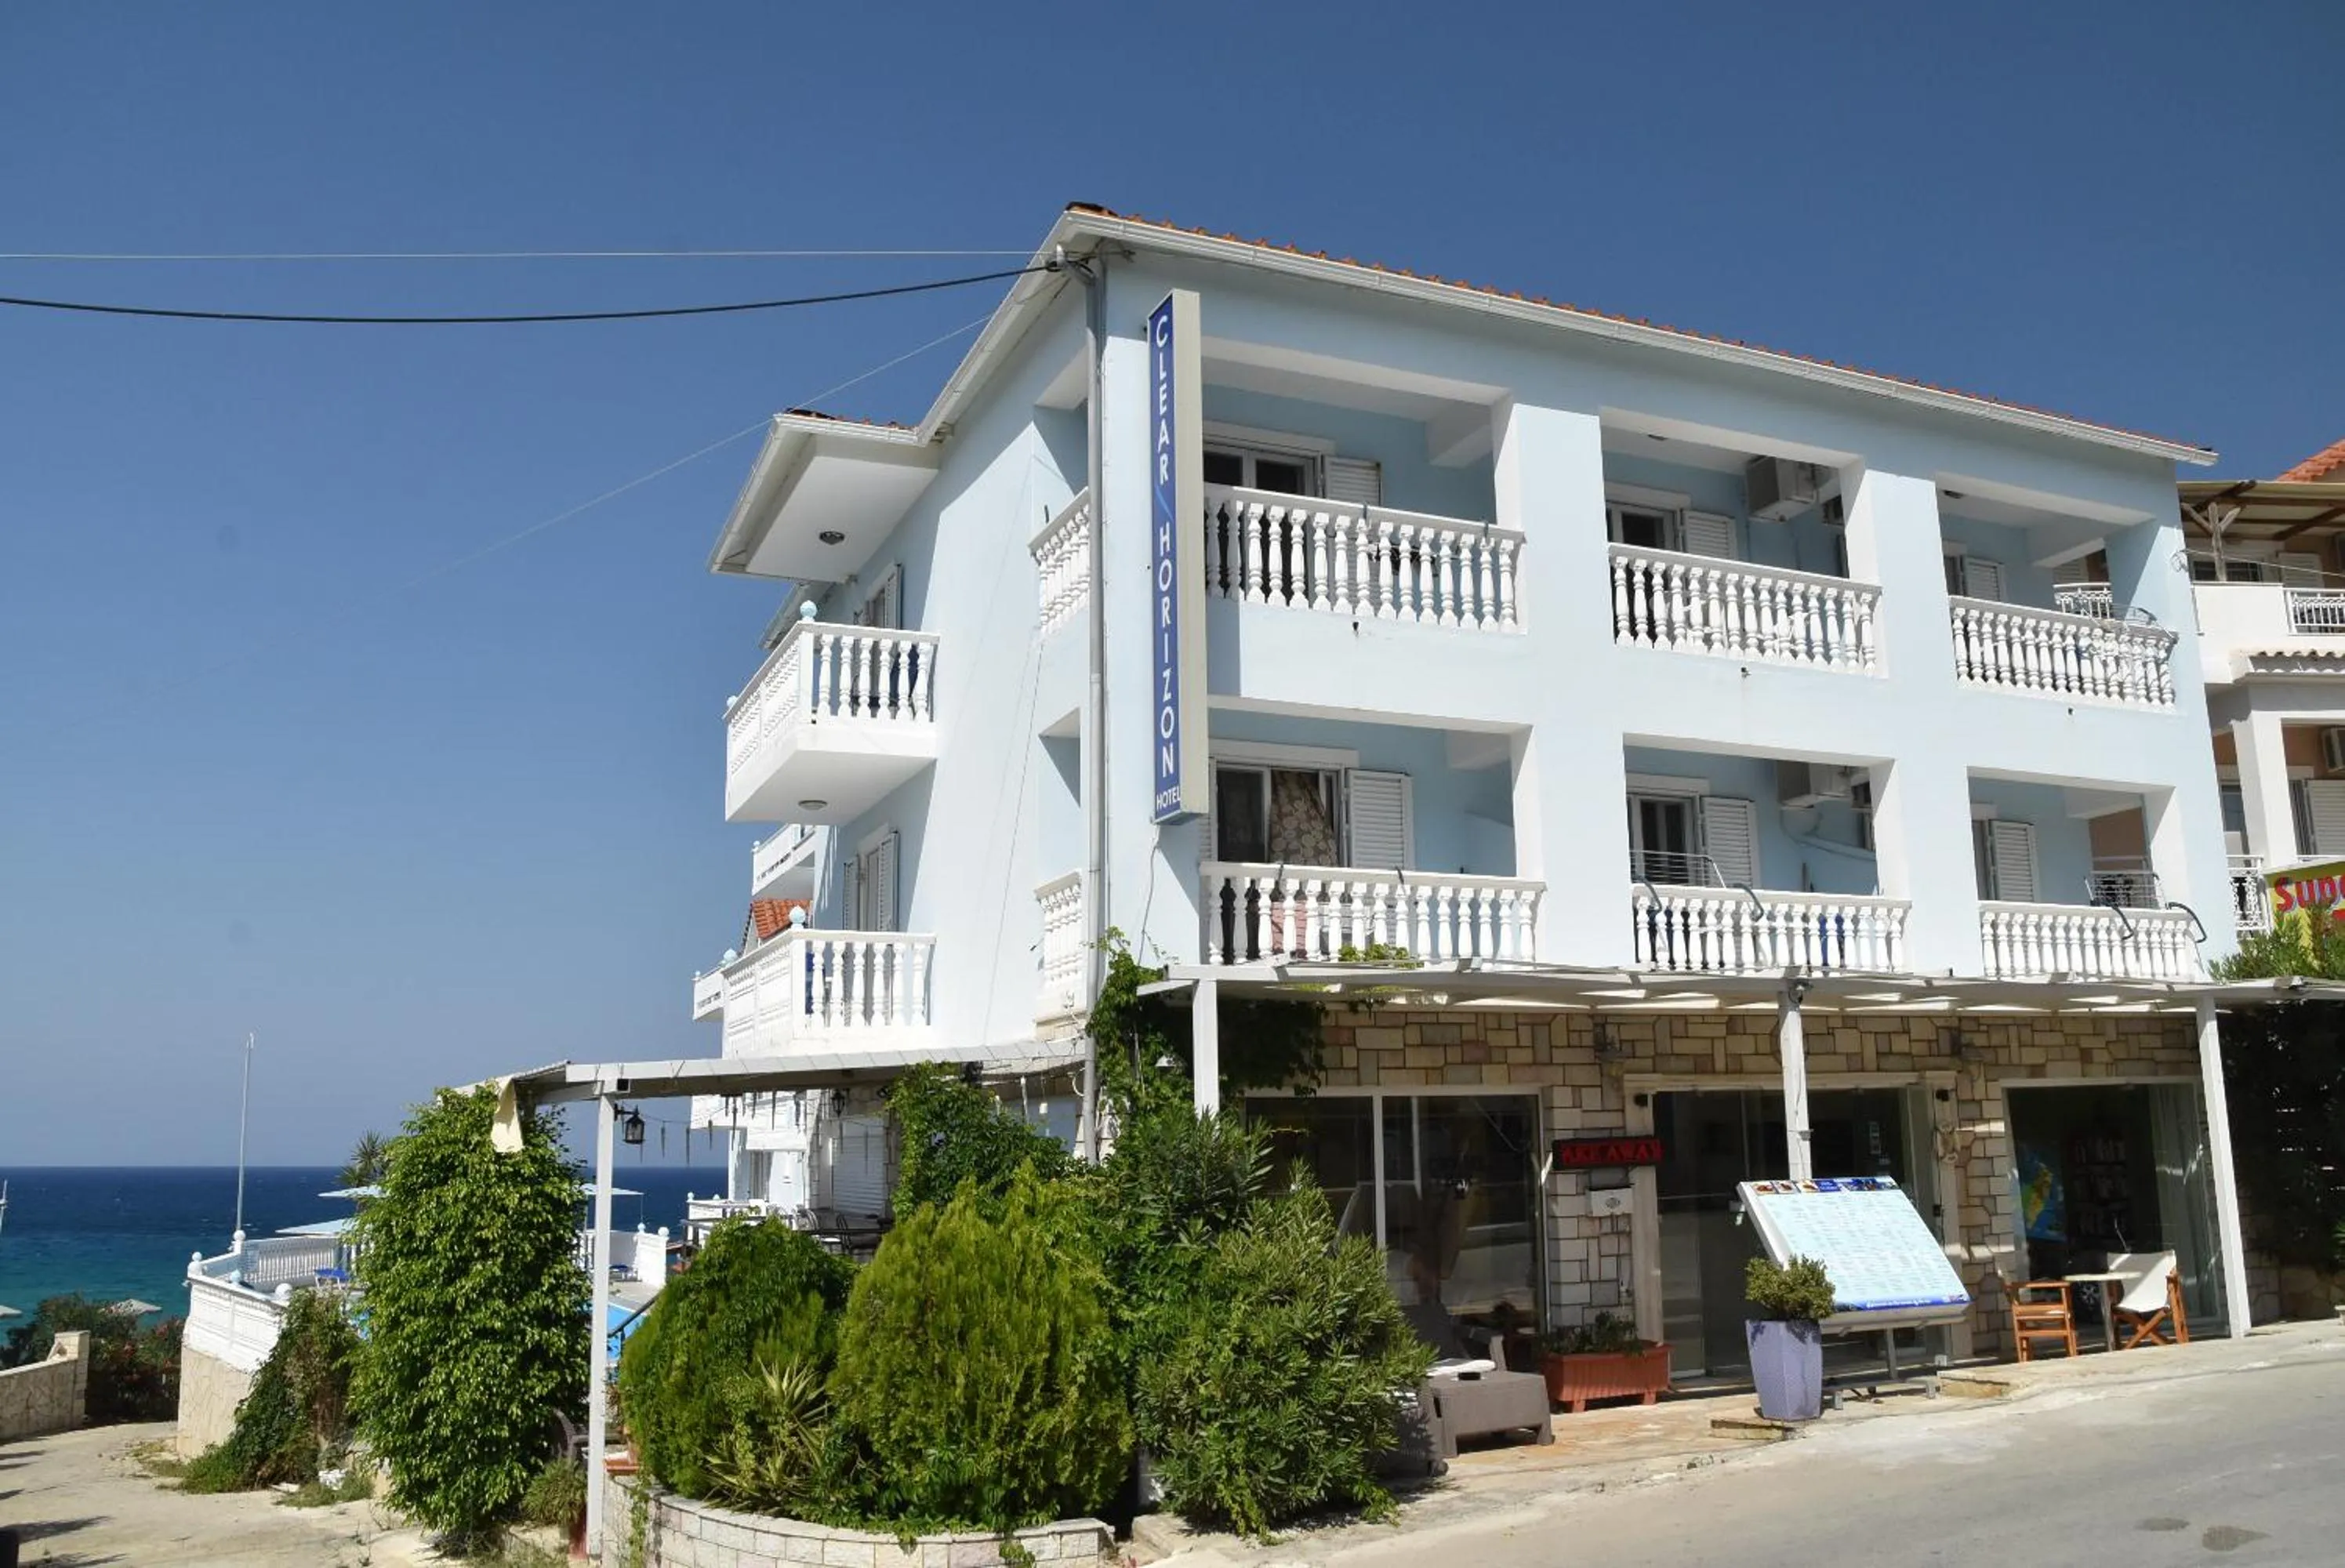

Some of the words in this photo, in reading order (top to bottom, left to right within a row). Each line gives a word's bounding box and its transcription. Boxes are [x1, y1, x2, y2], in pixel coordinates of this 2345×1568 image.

[1156, 315, 1171, 485] CLEAR
[1159, 522, 1174, 778] HORIZON
[1156, 786, 1181, 811] HOTEL
